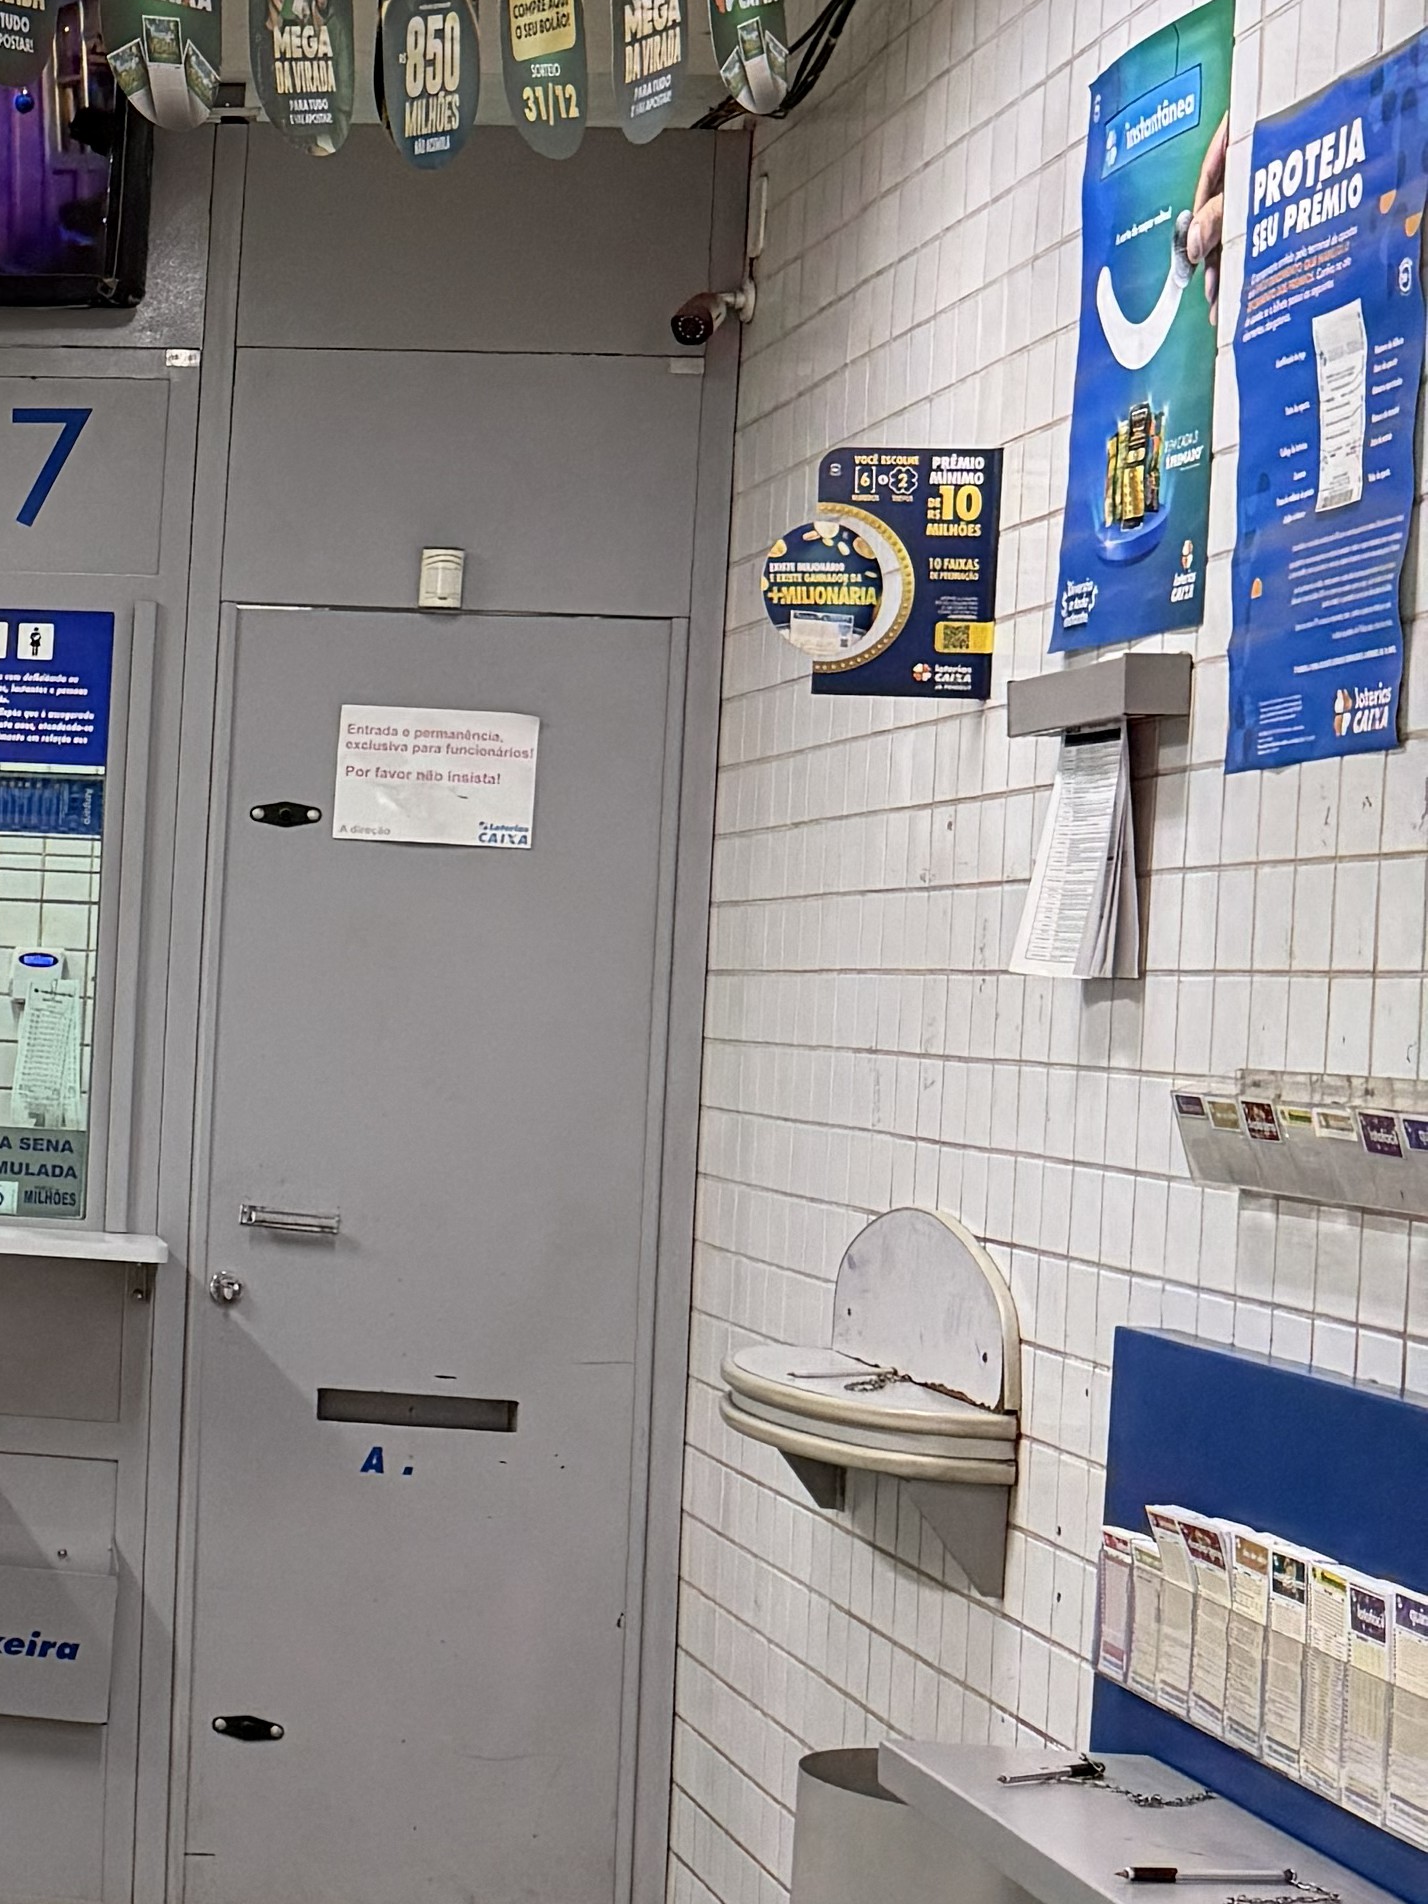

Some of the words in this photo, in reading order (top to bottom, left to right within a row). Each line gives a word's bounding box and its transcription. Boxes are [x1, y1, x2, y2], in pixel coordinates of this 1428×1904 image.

[523, 21, 538, 38] SEU
[406, 12, 461, 97] 850
[643, 28, 681, 77] VIRADA
[1125, 94, 1195, 149] instantânea
[1253, 117, 1365, 216] PROTEJA
[1252, 213, 1279, 258] SEU
[1283, 173, 1363, 239] PRÊMIO
[11, 407, 93, 527] 7
[932, 454, 985, 469] PRÊMIO
[939, 486, 982, 521] 10
[944, 558, 979, 570] FAIXAS
[346, 740, 408, 752] exclusiva
[413, 744, 441, 754] para
[446, 743, 534, 758] funcionários!
[345, 765, 370, 777] Por
[376, 767, 412, 779] favor
[416, 770, 443, 782] não
[448, 772, 501, 785] insista!
[19, 1137, 74, 1153] SENA
[24, 1187, 76, 1206] MILHÕES
